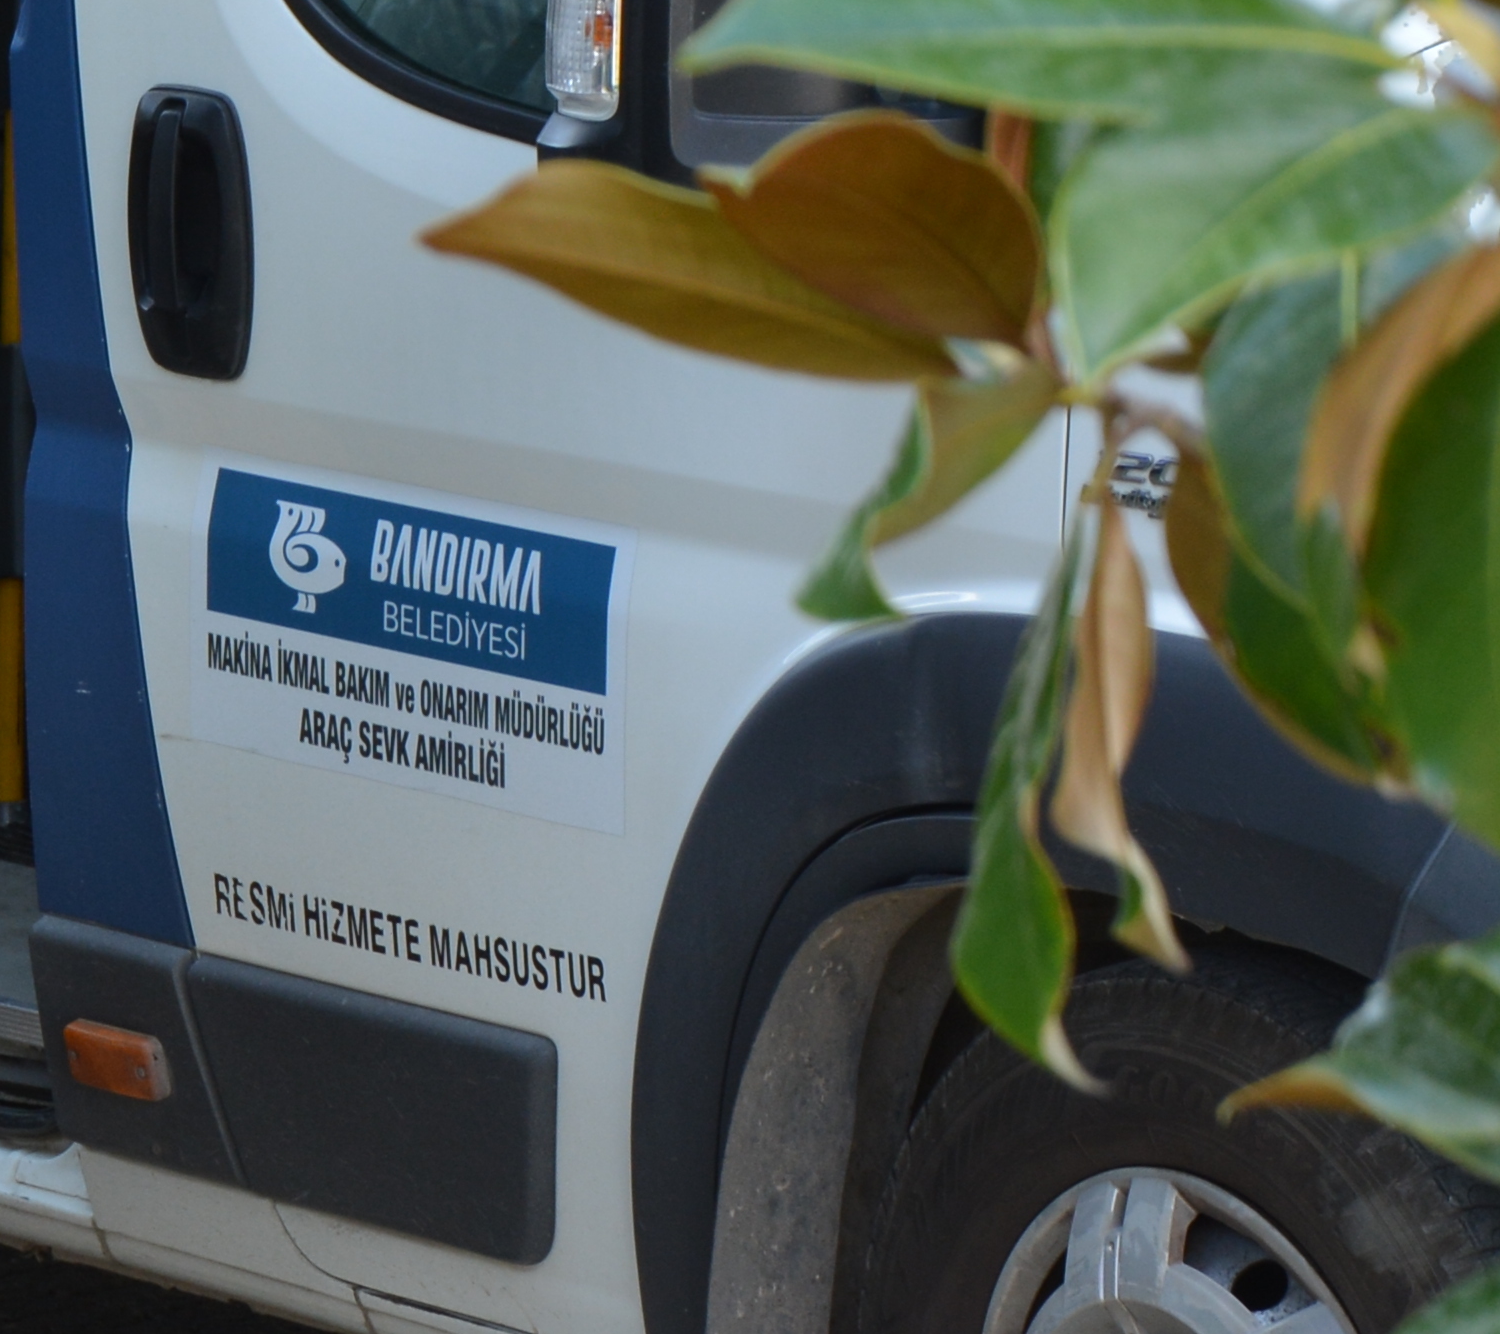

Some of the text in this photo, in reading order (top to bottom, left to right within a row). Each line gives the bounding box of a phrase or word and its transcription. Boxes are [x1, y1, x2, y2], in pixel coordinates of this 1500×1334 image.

[370, 519, 542, 615] BANDIRMA
[383, 600, 526, 661] BELEDİYESİ
[207, 631, 606, 756] MAKİNA İKMAL BAKIM ve ONARIM MÜDÜRLÜĞÜ
[299, 708, 506, 789] ARAÇ SEVK AMİRLİĞİ
[429, 924, 608, 1003] MAHSUSTUR
